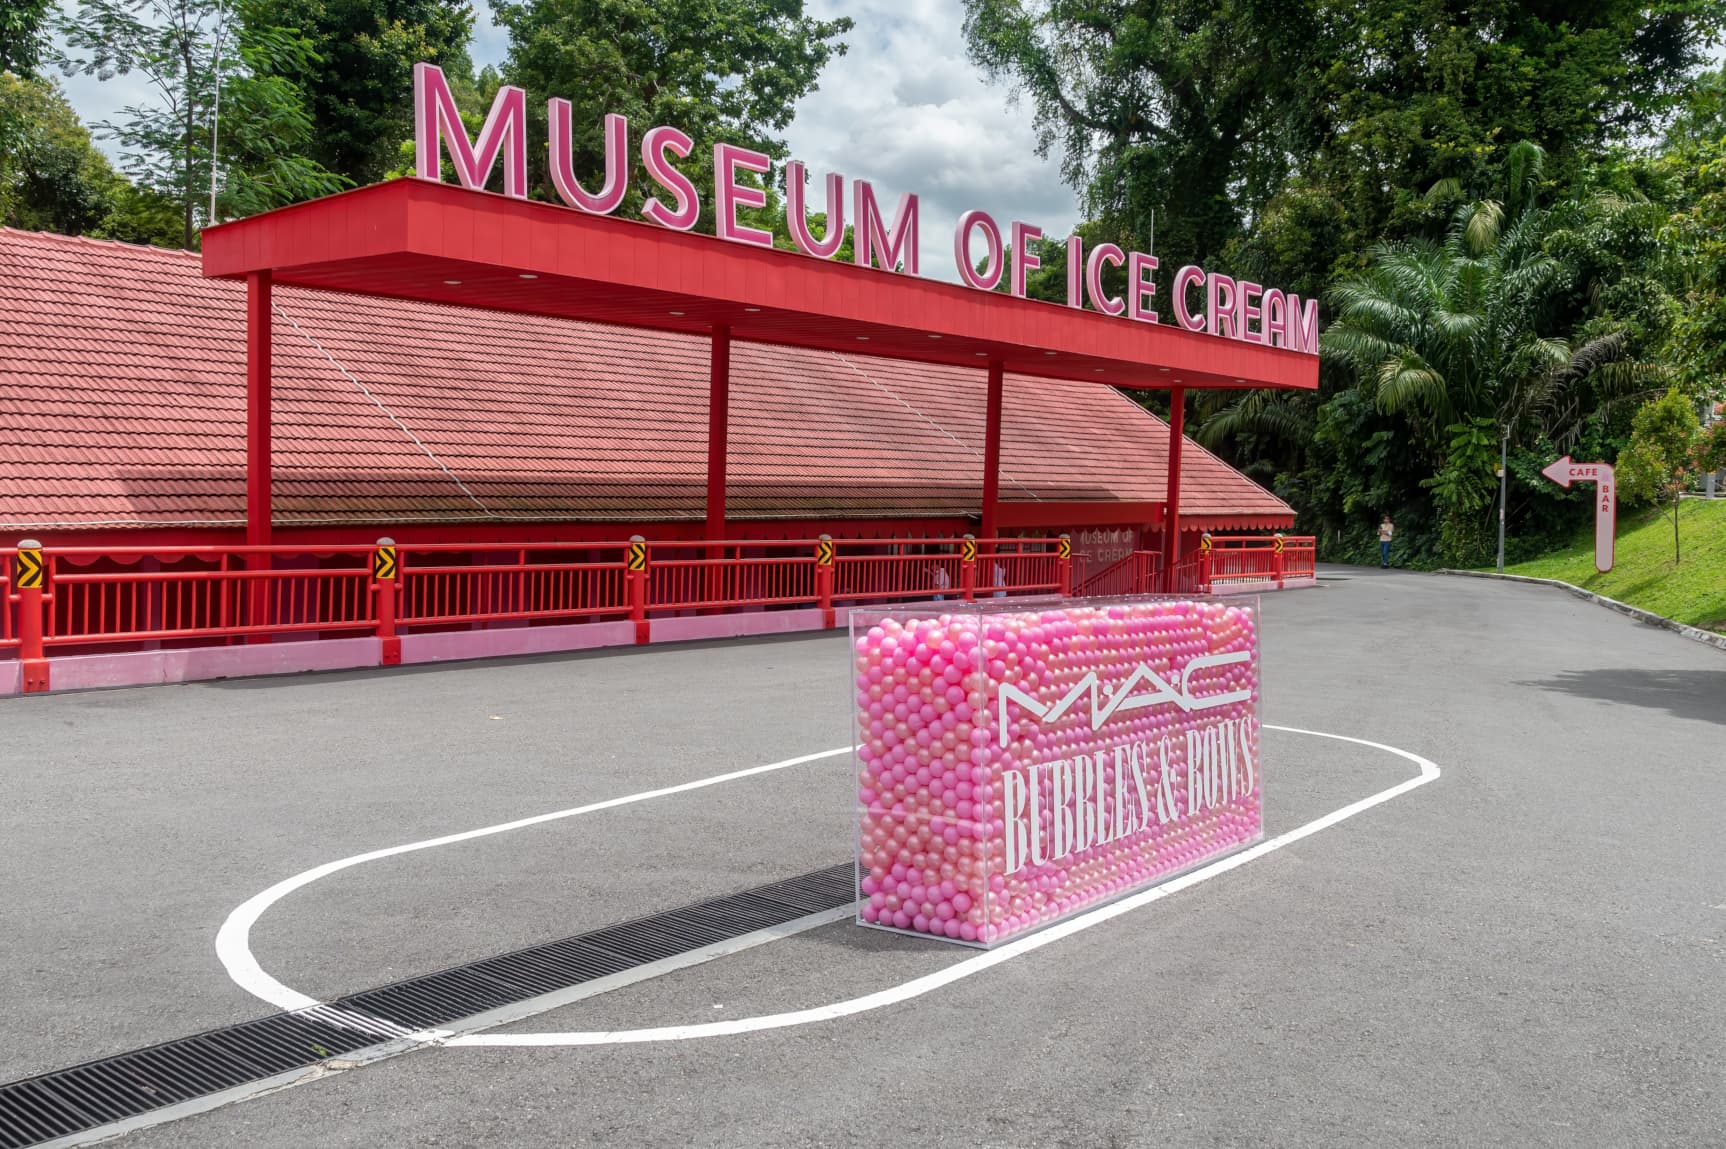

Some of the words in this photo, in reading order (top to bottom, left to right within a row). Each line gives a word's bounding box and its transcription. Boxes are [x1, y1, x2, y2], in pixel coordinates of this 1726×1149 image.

[414, 62, 920, 276] MUSEUM
[954, 209, 1042, 299] OF
[1067, 235, 1158, 324] ICE
[1172, 265, 1319, 355] CREAM
[1569, 468, 1598, 476] CAFE
[1001, 740, 1149, 876] BUBBLES
[1157, 735, 1180, 825] &
[1185, 716, 1254, 817] BOWS
